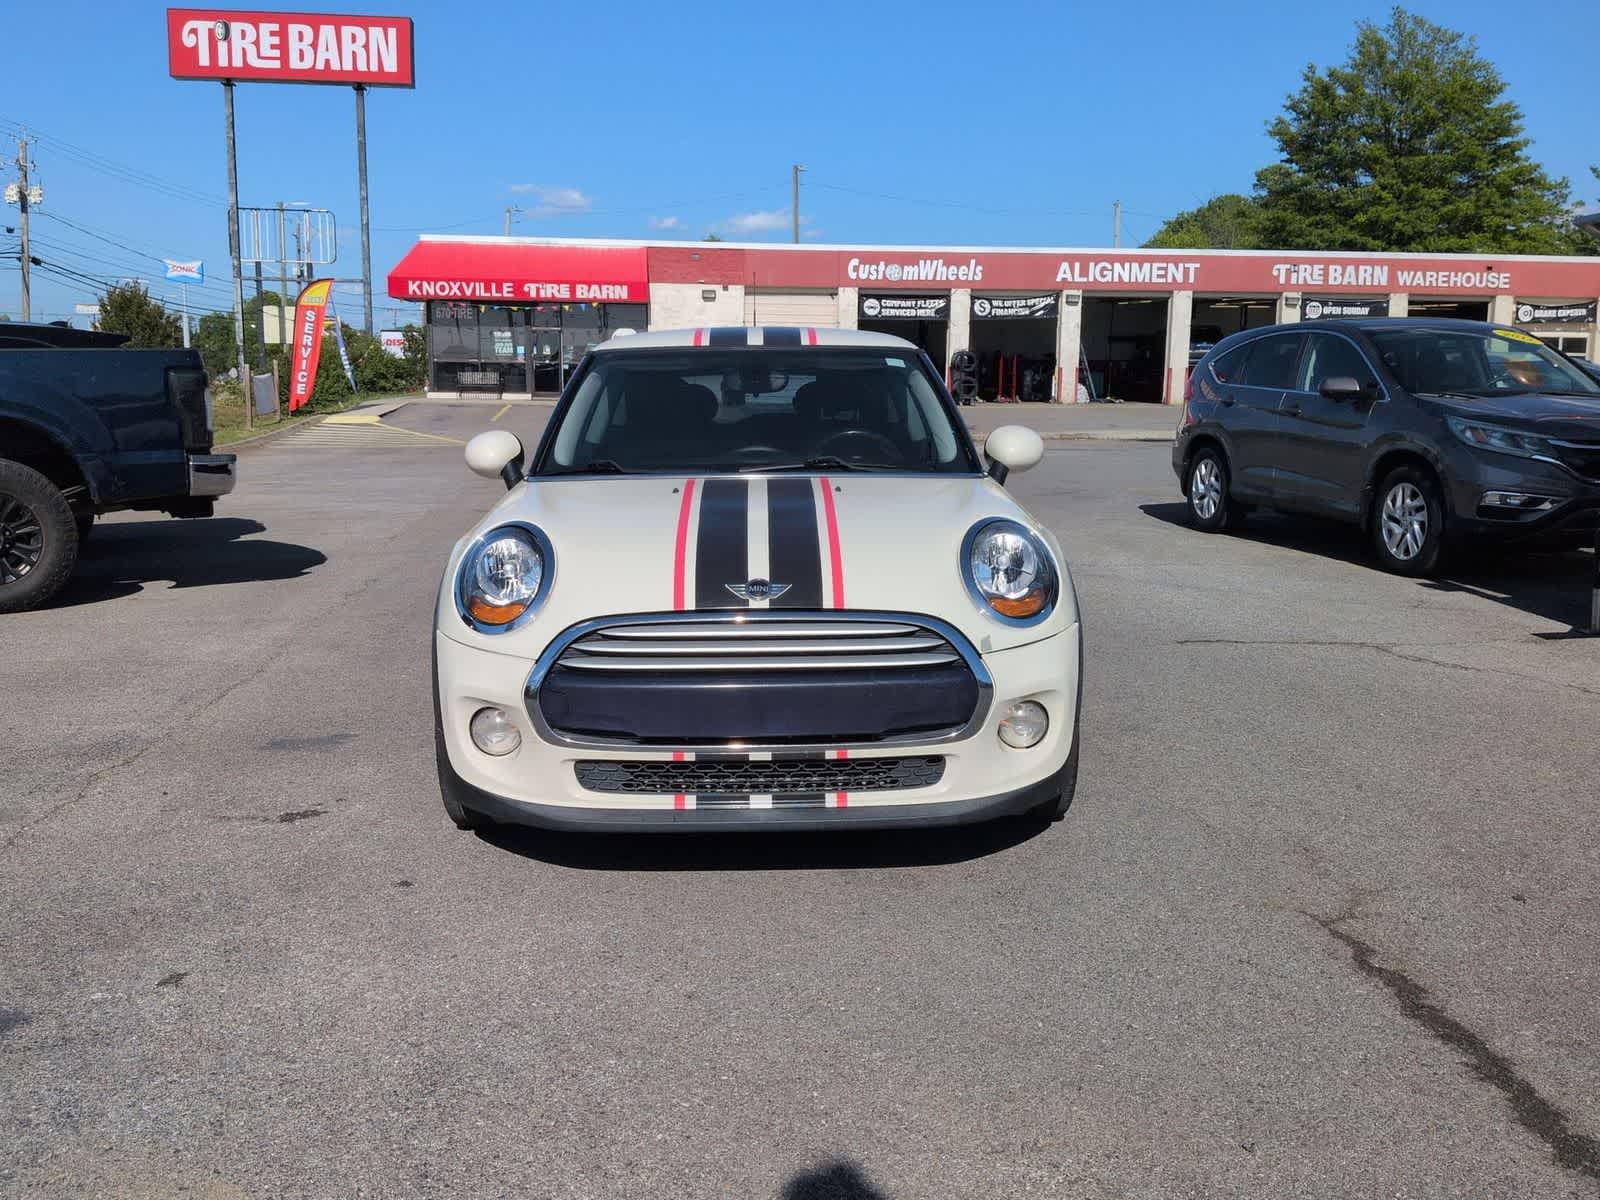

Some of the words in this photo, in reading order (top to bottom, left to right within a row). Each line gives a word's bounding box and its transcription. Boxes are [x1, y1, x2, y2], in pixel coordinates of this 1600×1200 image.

[287, 23, 398, 73] BARN
[171, 264, 195, 273] SONIC
[1055, 261, 1201, 283] ALIGNMENT
[1328, 264, 1389, 286] BARN
[1397, 271, 1511, 289] WAREHOUSE
[407, 280, 515, 298] KNOXVILLE
[575, 283, 629, 300] BARN
[881, 299, 916, 308] COMPANY
[1323, 306, 1342, 315] OPEN
[1342, 306, 1370, 315] SUNDAY
[881, 308, 917, 317] SERVICED
[296, 310, 317, 395] SERVICE
[748, 585, 769, 593] MINI
